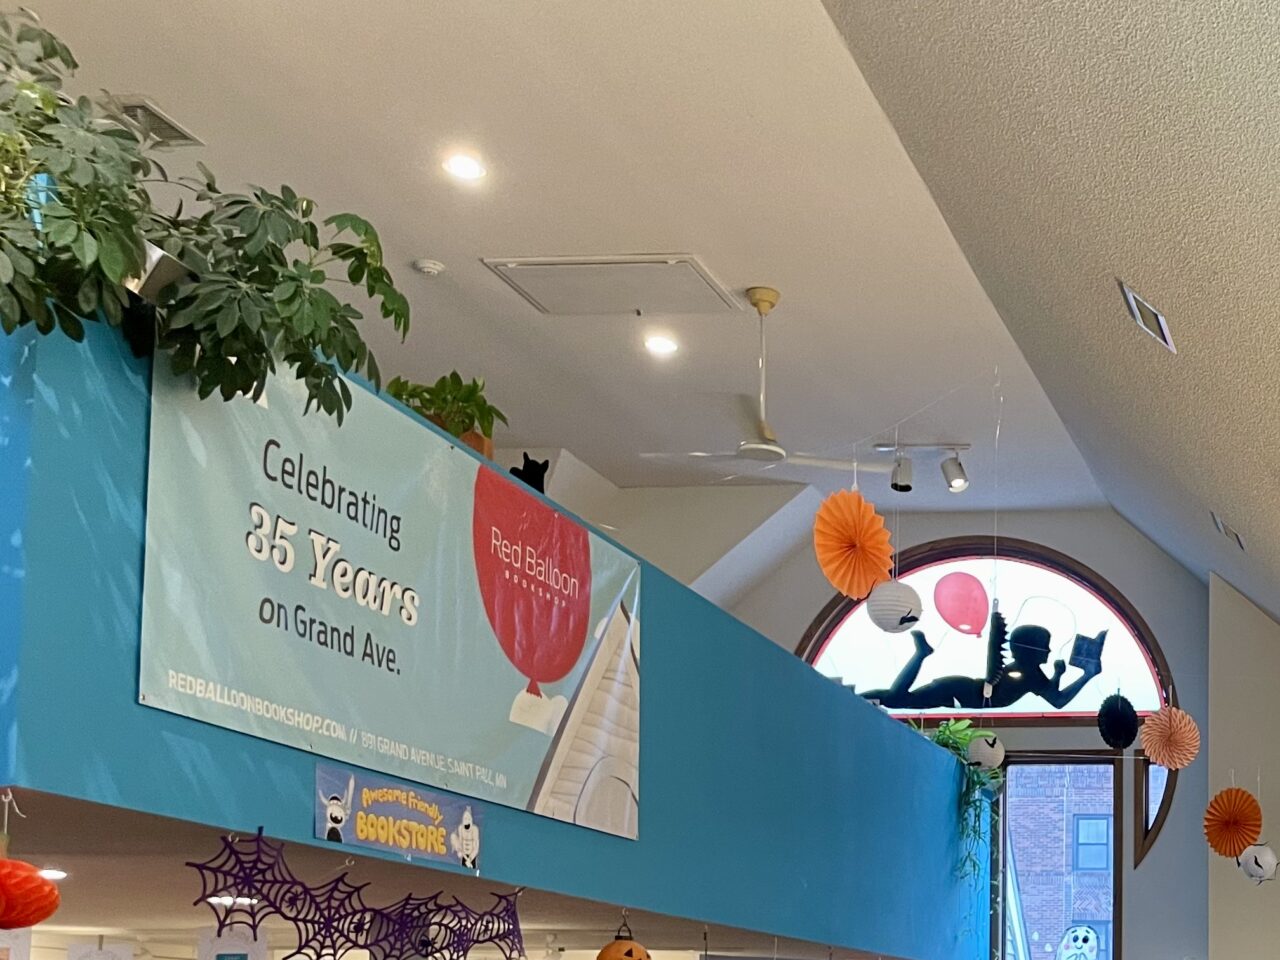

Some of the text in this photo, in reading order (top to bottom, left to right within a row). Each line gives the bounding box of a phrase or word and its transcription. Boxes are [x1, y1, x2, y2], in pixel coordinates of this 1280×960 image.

[263, 439, 401, 551] Celebrating
[246, 502, 420, 627] 35 Years
[491, 526, 579, 599] Red Balloon
[259, 597, 401, 675] on Grand Ave.
[168, 669, 347, 741] REDBALLOONBOOKSHOP.COM
[376, 738, 410, 761] GRAND
[448, 757, 474, 780] SAINT
[355, 811, 447, 855] BOOKSTORE
[361, 786, 407, 808] Awesome
